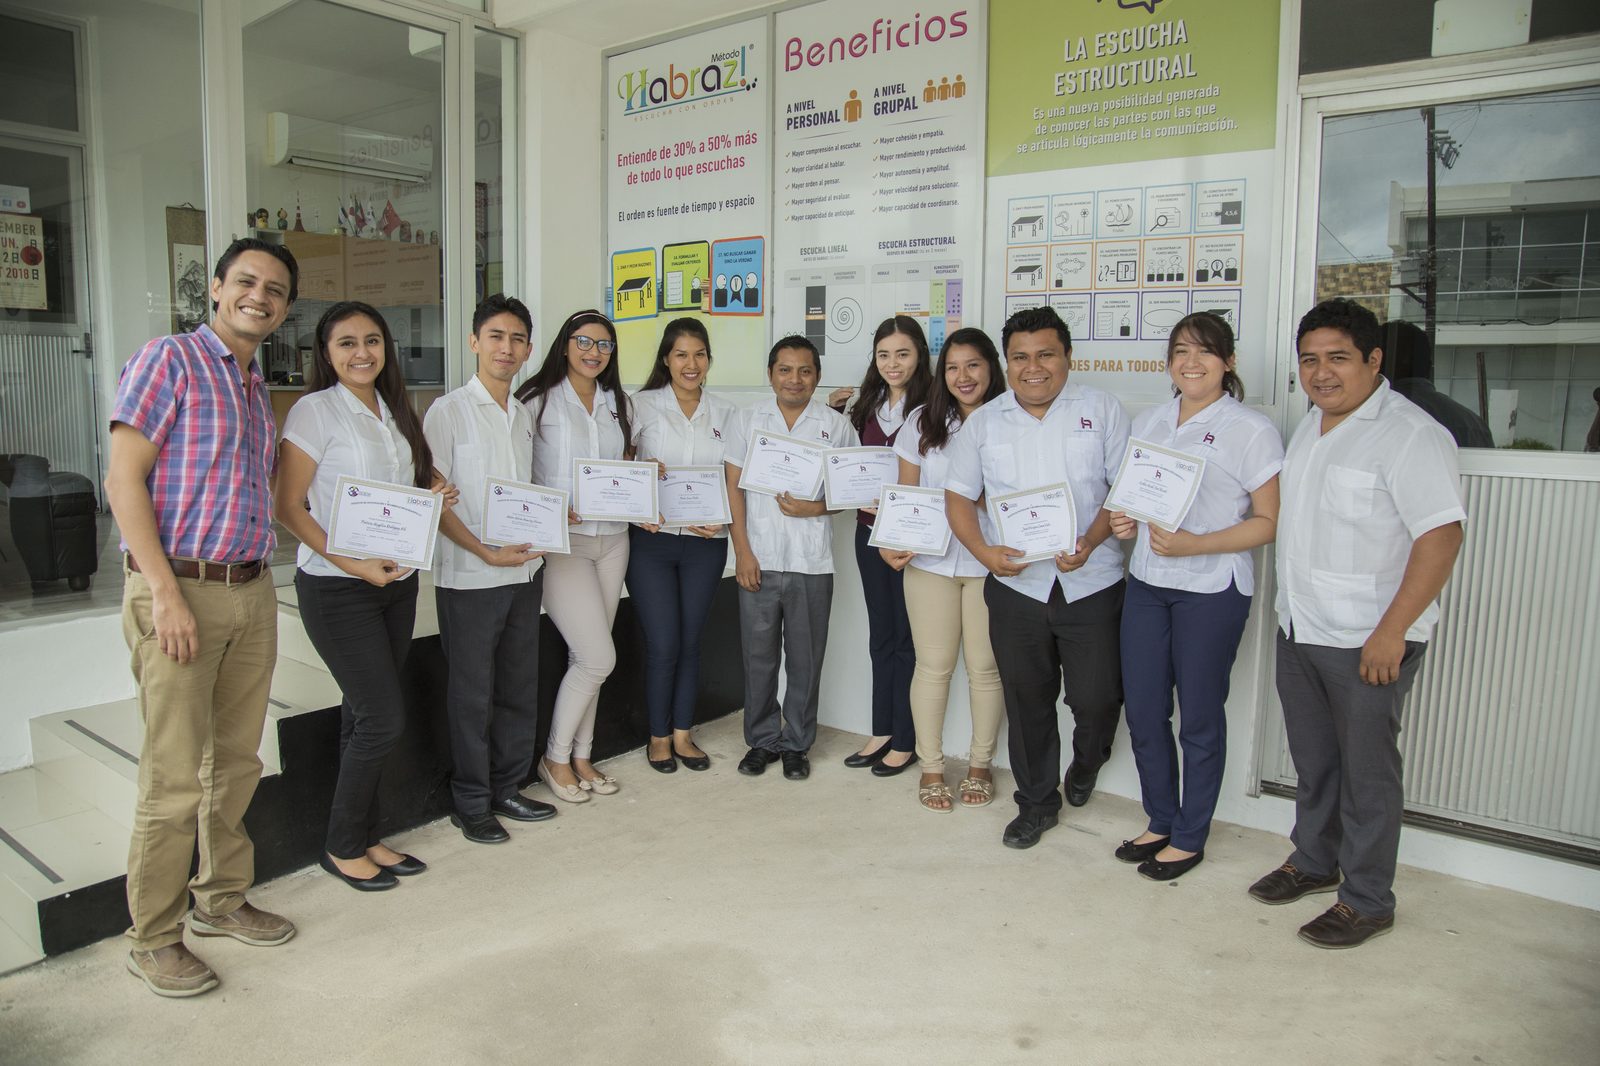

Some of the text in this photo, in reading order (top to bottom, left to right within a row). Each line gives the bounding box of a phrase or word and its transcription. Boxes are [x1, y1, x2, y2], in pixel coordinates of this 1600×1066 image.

[785, 10, 968, 72] Beneficios
[1064, 19, 1188, 63] LA ESCUCHA
[711, 49, 740, 63] Método
[1054, 52, 1197, 96] ESTRUCTURAL
[874, 83, 906, 98] A NIVEL
[634, 96, 734, 122] ESCUCHA CON ORDEN
[786, 100, 815, 114] A NIVEL
[874, 96, 918, 116] GRUPAL
[1033, 84, 1219, 120] Es una nueva posibilidad generada
[786, 110, 840, 130] PERSONAL
[1035, 104, 1217, 136] de conocer las partes con las que
[880, 137, 894, 145] Mayor
[896, 133, 917, 143] cohesión
[1017, 116, 1238, 154] se articula lógicamente la comunicación.
[617, 130, 757, 167] Entiende de 30% a 50% más
[792, 150, 804, 158] Mayor
[806, 145, 834, 155] comprensión
[880, 154, 894, 162] Mayor
[895, 150, 925, 159] rendimiento
[930, 144, 967, 156] productividad.
[627, 155, 745, 185] de todo lo que escuchas
[792, 166, 804, 174] Mayor
[806, 164, 823, 172] claridad
[880, 171, 893, 179] Mayor
[792, 182, 804, 190] Mayor
[895, 185, 918, 193] velocidad
[806, 196, 826, 204] seguridad
[618, 194, 755, 222] El orden es fuente de tiempo y espacio
[879, 206, 893, 214] Mayor
[894, 202, 919, 212] capacidad
[805, 212, 827, 221] capacidad
[878, 236, 956, 249] ESCUCHA ESTRUCTURAL
[800, 245, 848, 255] ESCUCHA LINEAL
[6, 268, 29, 279] 2018
[1094, 360, 1123, 372] PARA
[1128, 360, 1165, 372] TODOS
